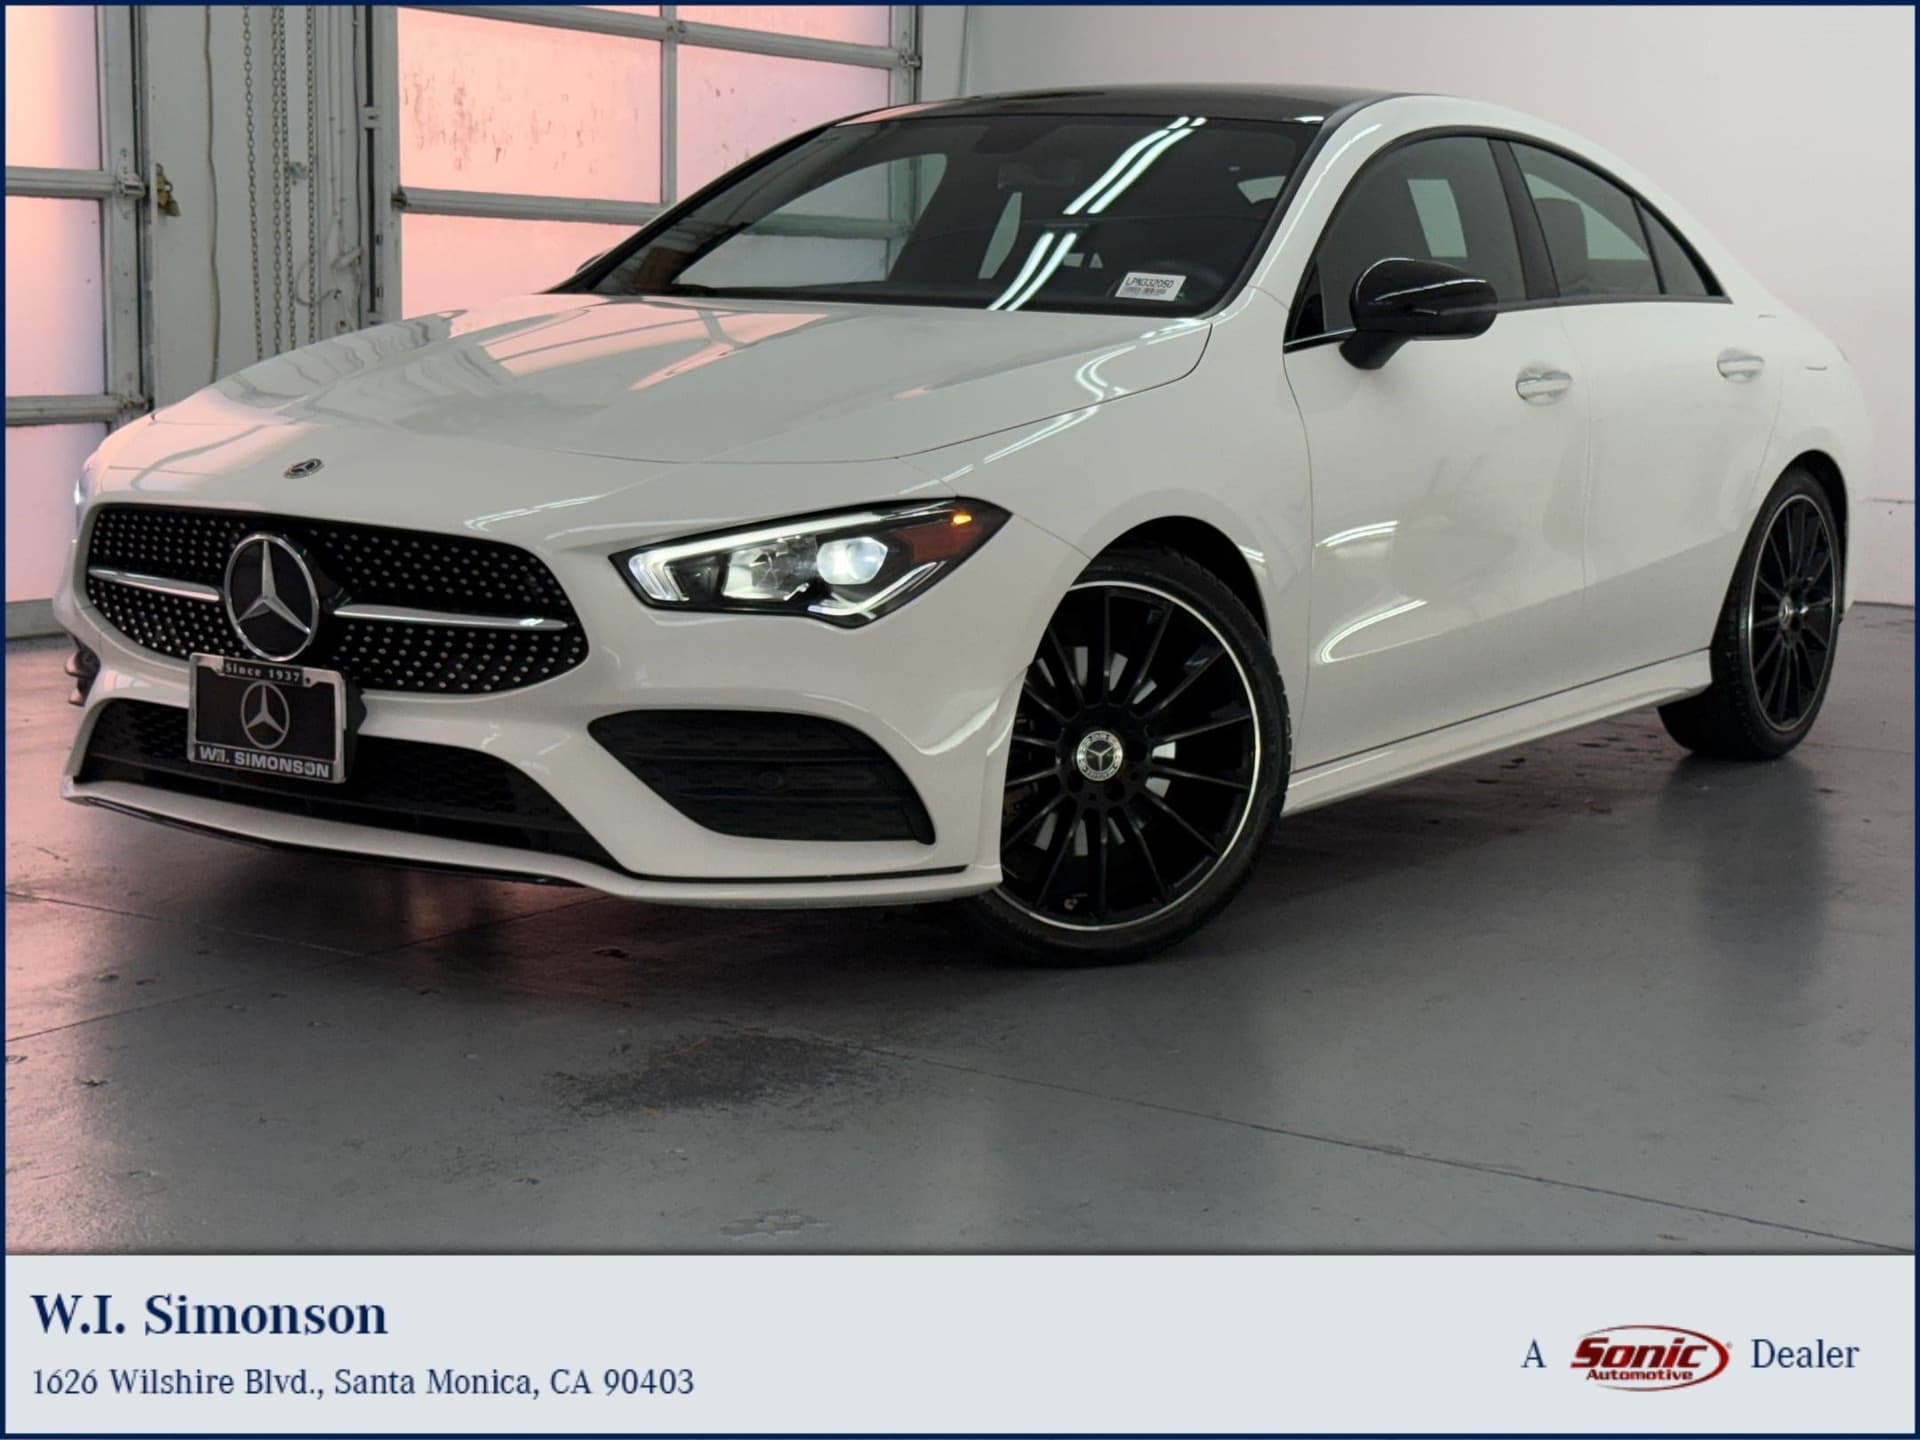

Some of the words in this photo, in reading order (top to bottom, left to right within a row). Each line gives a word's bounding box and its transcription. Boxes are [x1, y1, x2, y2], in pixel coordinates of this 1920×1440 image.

[225, 663, 262, 676] Since
[269, 668, 301, 683] 1937
[234, 750, 330, 778] SIMONSON
